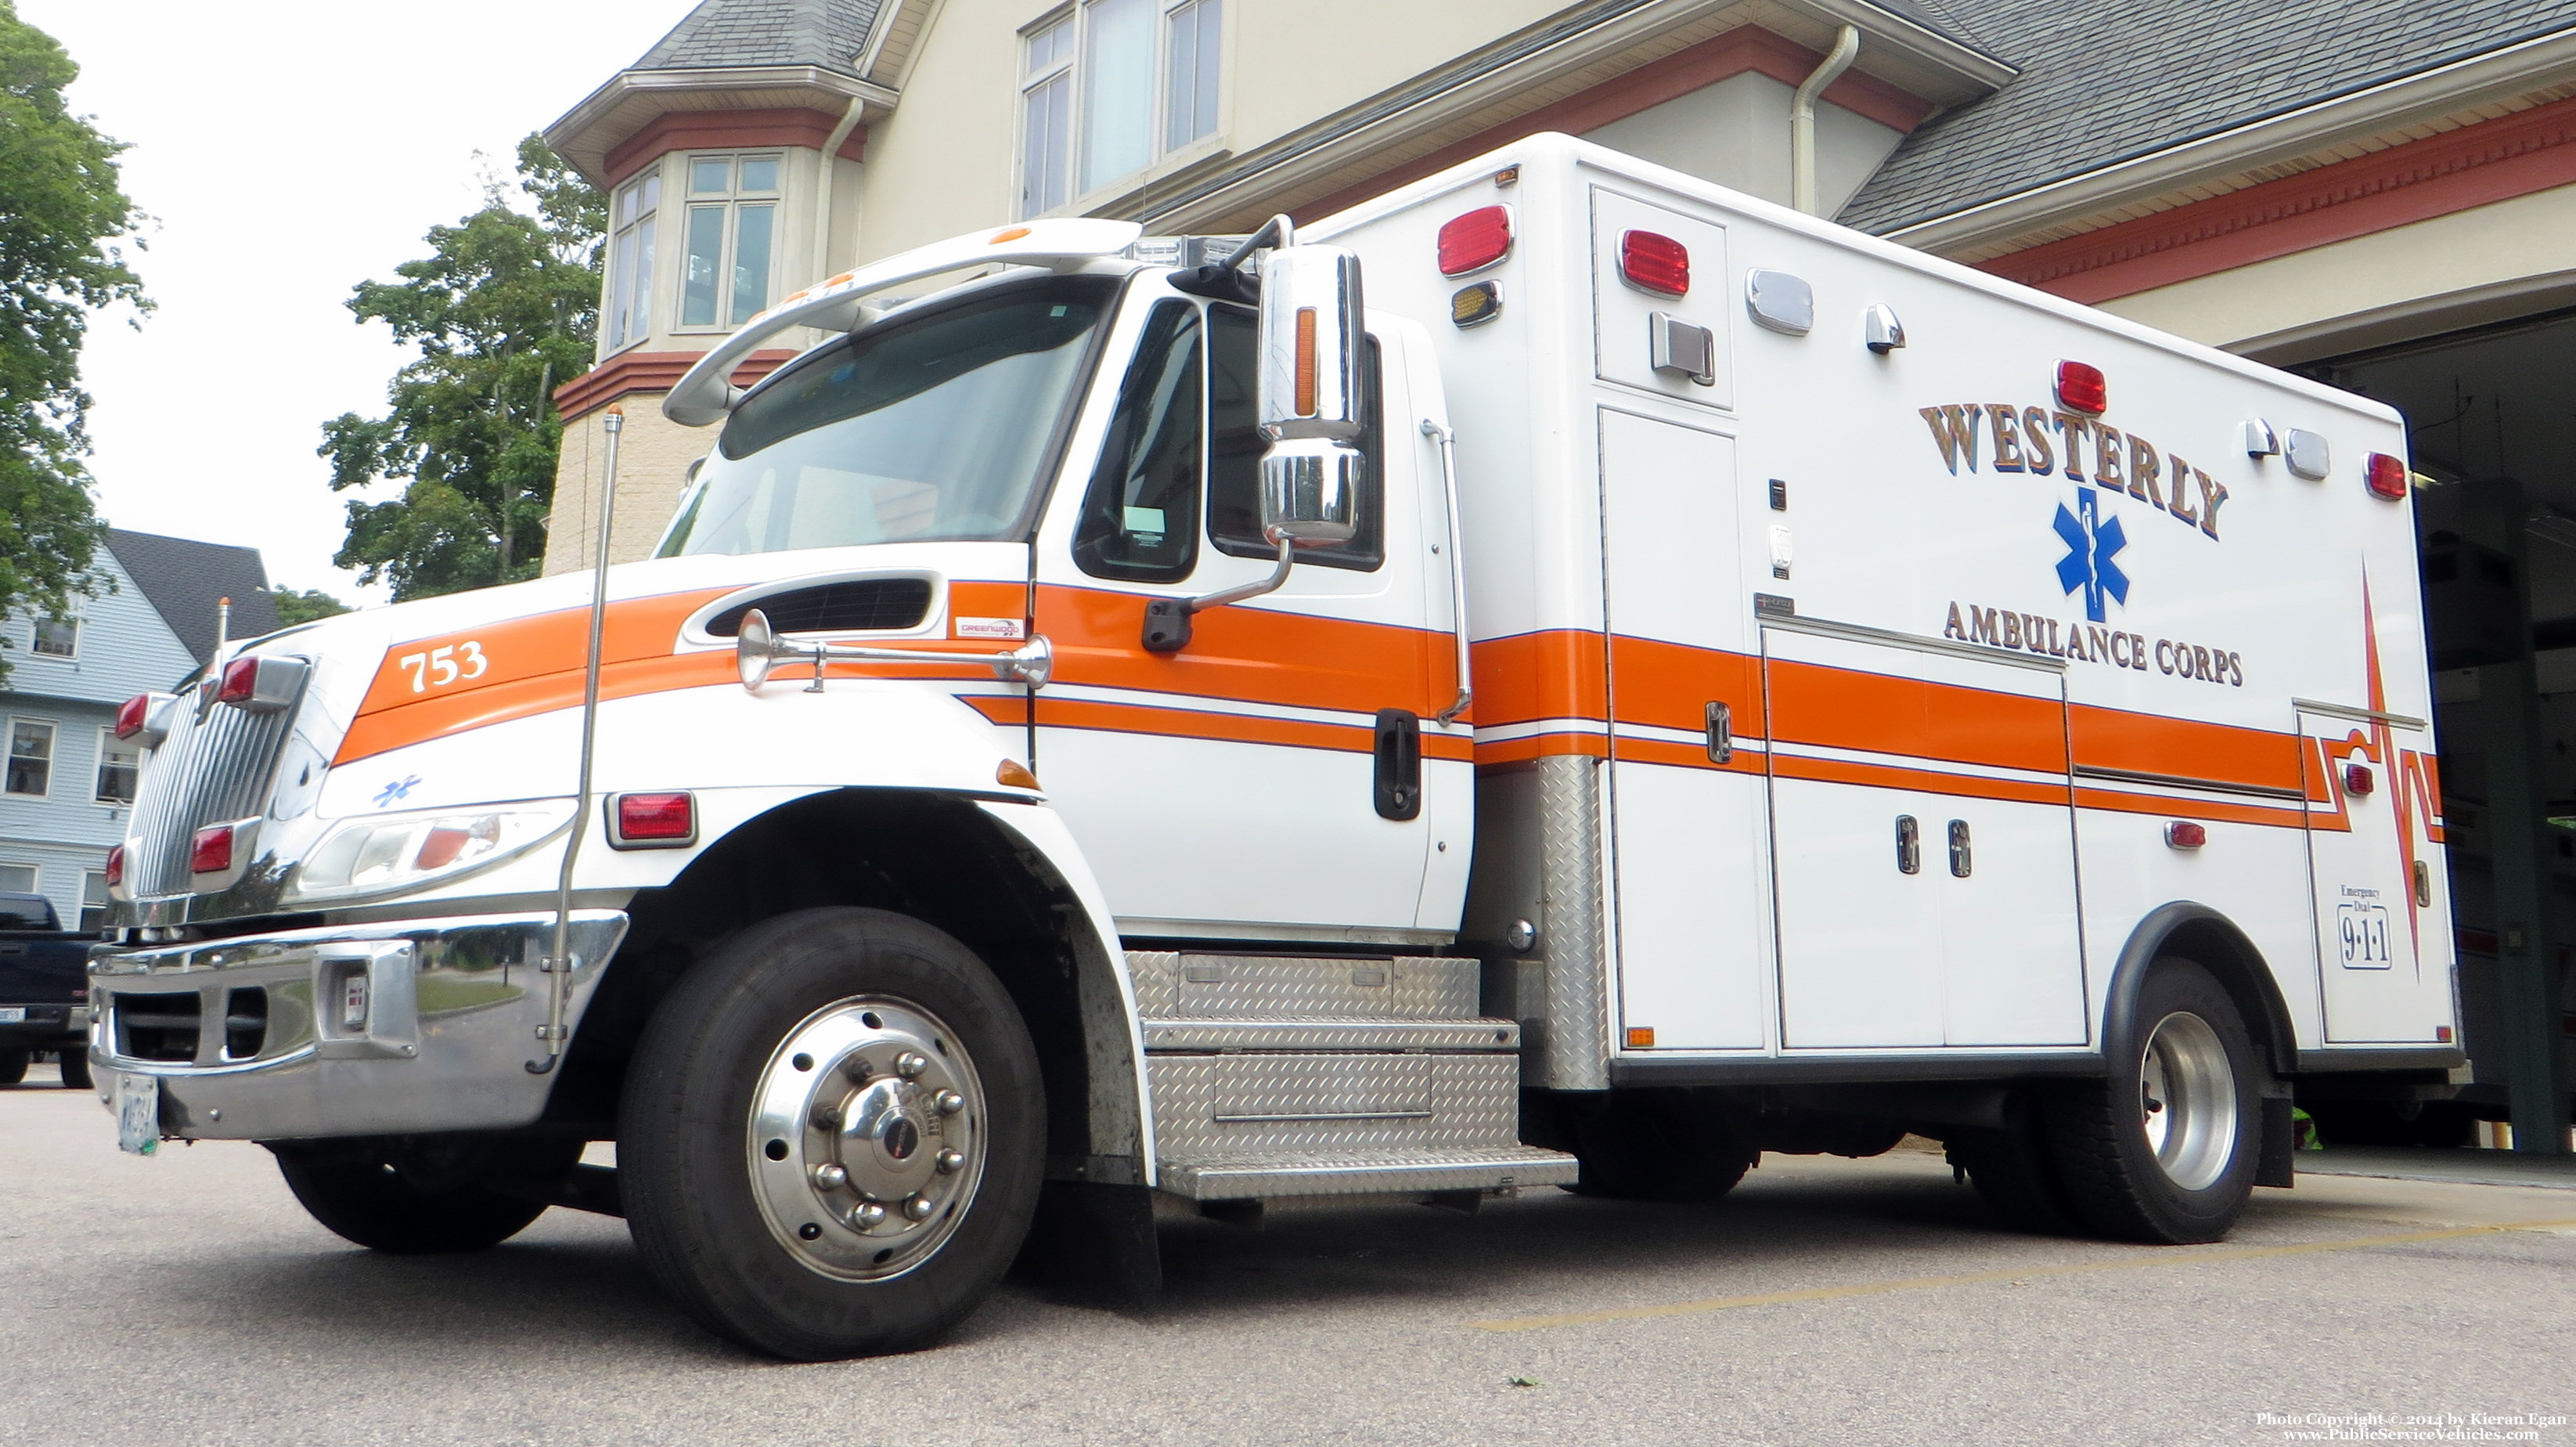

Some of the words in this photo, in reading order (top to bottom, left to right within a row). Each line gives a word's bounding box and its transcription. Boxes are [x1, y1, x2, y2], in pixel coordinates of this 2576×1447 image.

[1918, 402, 2229, 542] WESTERLY
[400, 641, 488, 693] 753
[1944, 601, 2148, 672] AMBULANCE
[2155, 638, 2243, 687] CORPS
[2340, 885, 2380, 900] Emergency
[2354, 900, 2371, 912] Dial
